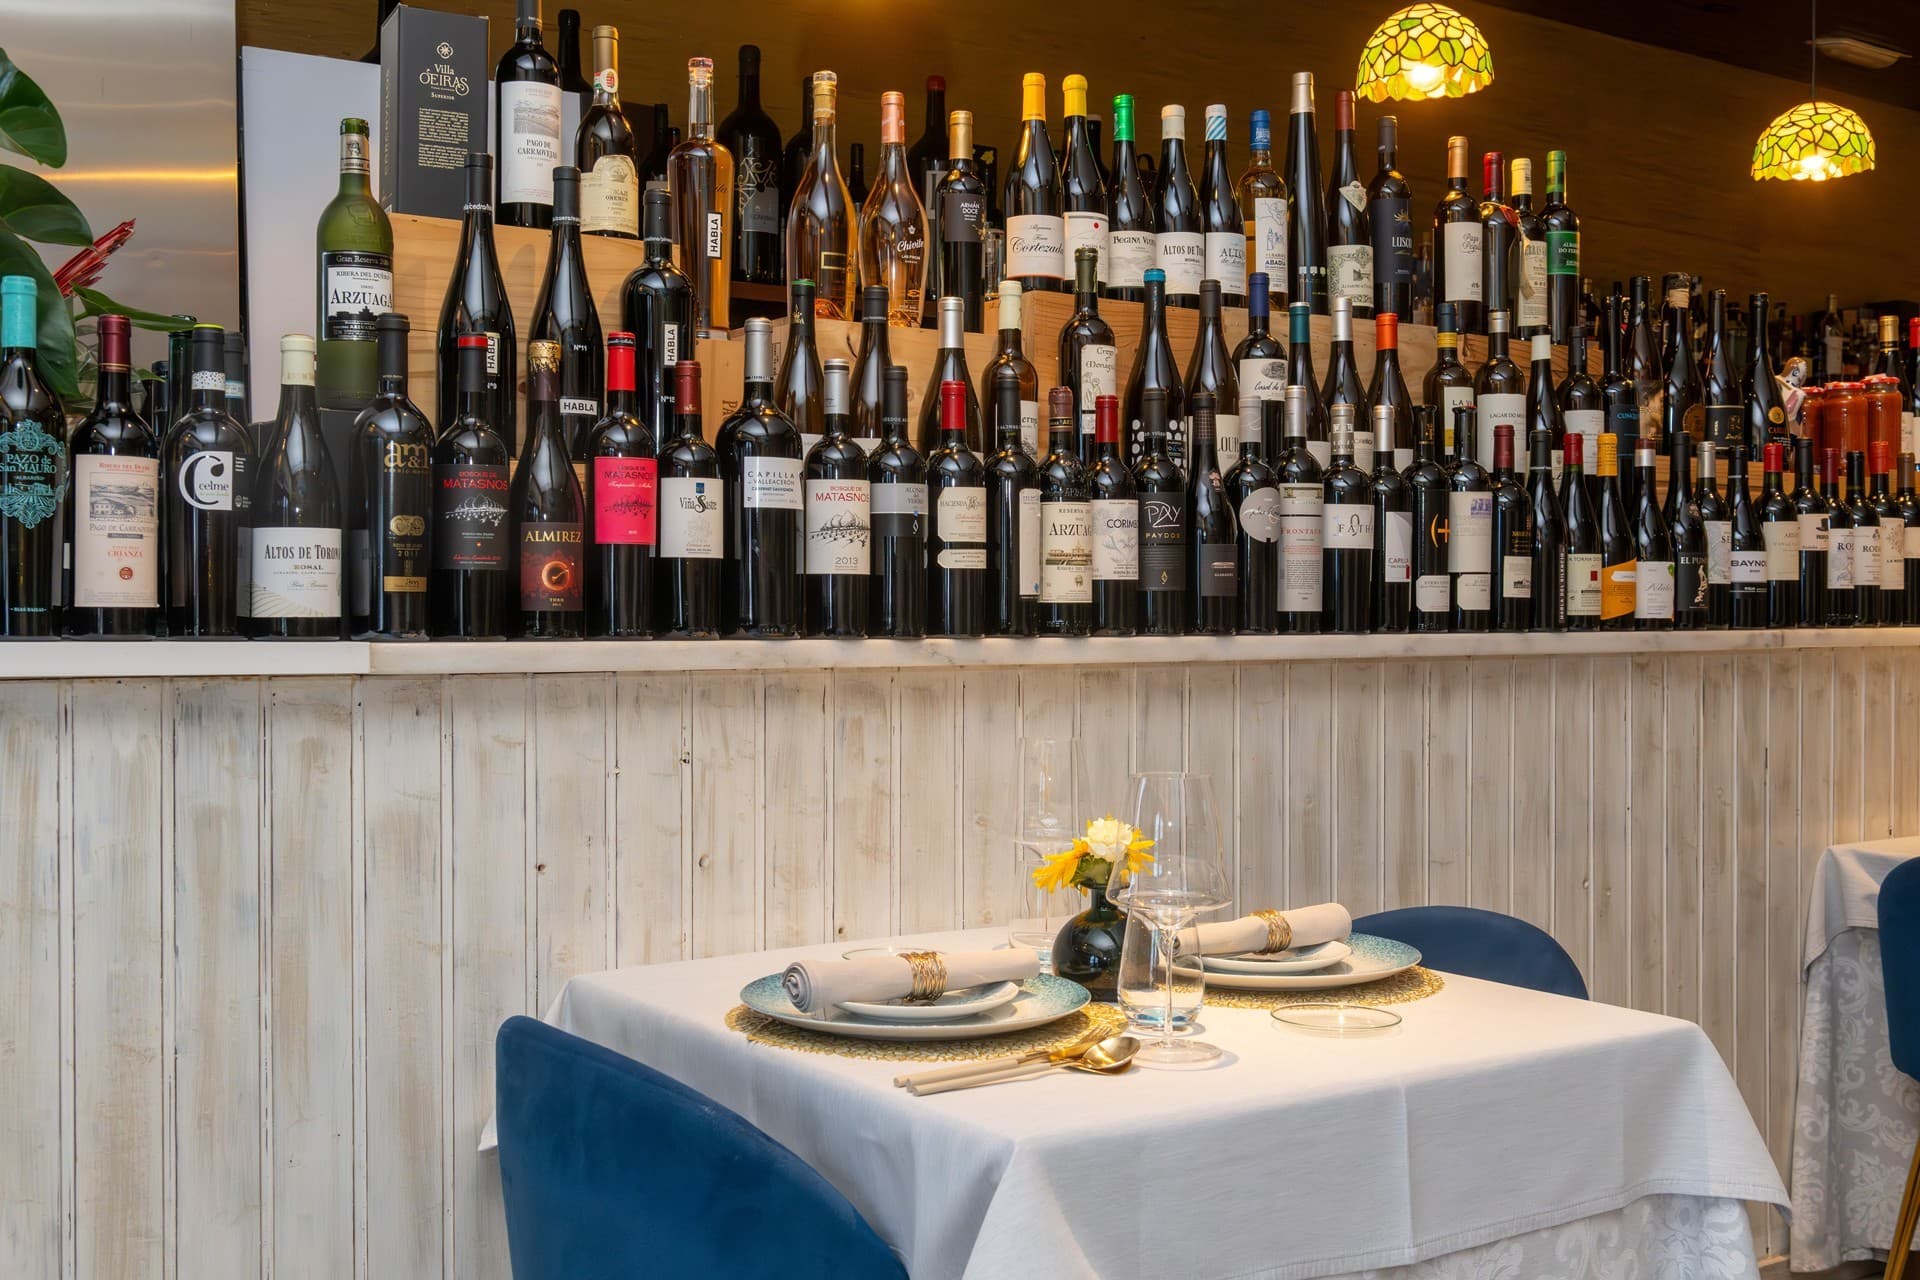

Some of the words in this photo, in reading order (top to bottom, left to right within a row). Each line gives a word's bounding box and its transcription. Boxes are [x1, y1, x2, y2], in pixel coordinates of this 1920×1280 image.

[434, 64, 455, 75] Villa
[710, 218, 719, 253] HABLA
[1163, 245, 1185, 256] ALTOS
[1187, 245, 1196, 256] DE
[667, 329, 675, 362] HABLA
[487, 336, 497, 369] HABLA
[563, 401, 594, 412] HABLA
[6, 454, 39, 464] PAZO
[41, 456, 51, 465] de
[16, 464, 57, 474] MAURO
[747, 470, 795, 479] CAPILLA
[198, 480, 230, 491] celme
[443, 479, 508, 490] MATASNOS
[679, 497, 695, 510] Viña
[525, 531, 582, 543] ALMIREZ
[264, 545, 294, 559] ALTOS
[299, 545, 311, 559] DE
[835, 556, 858, 565] 2013
